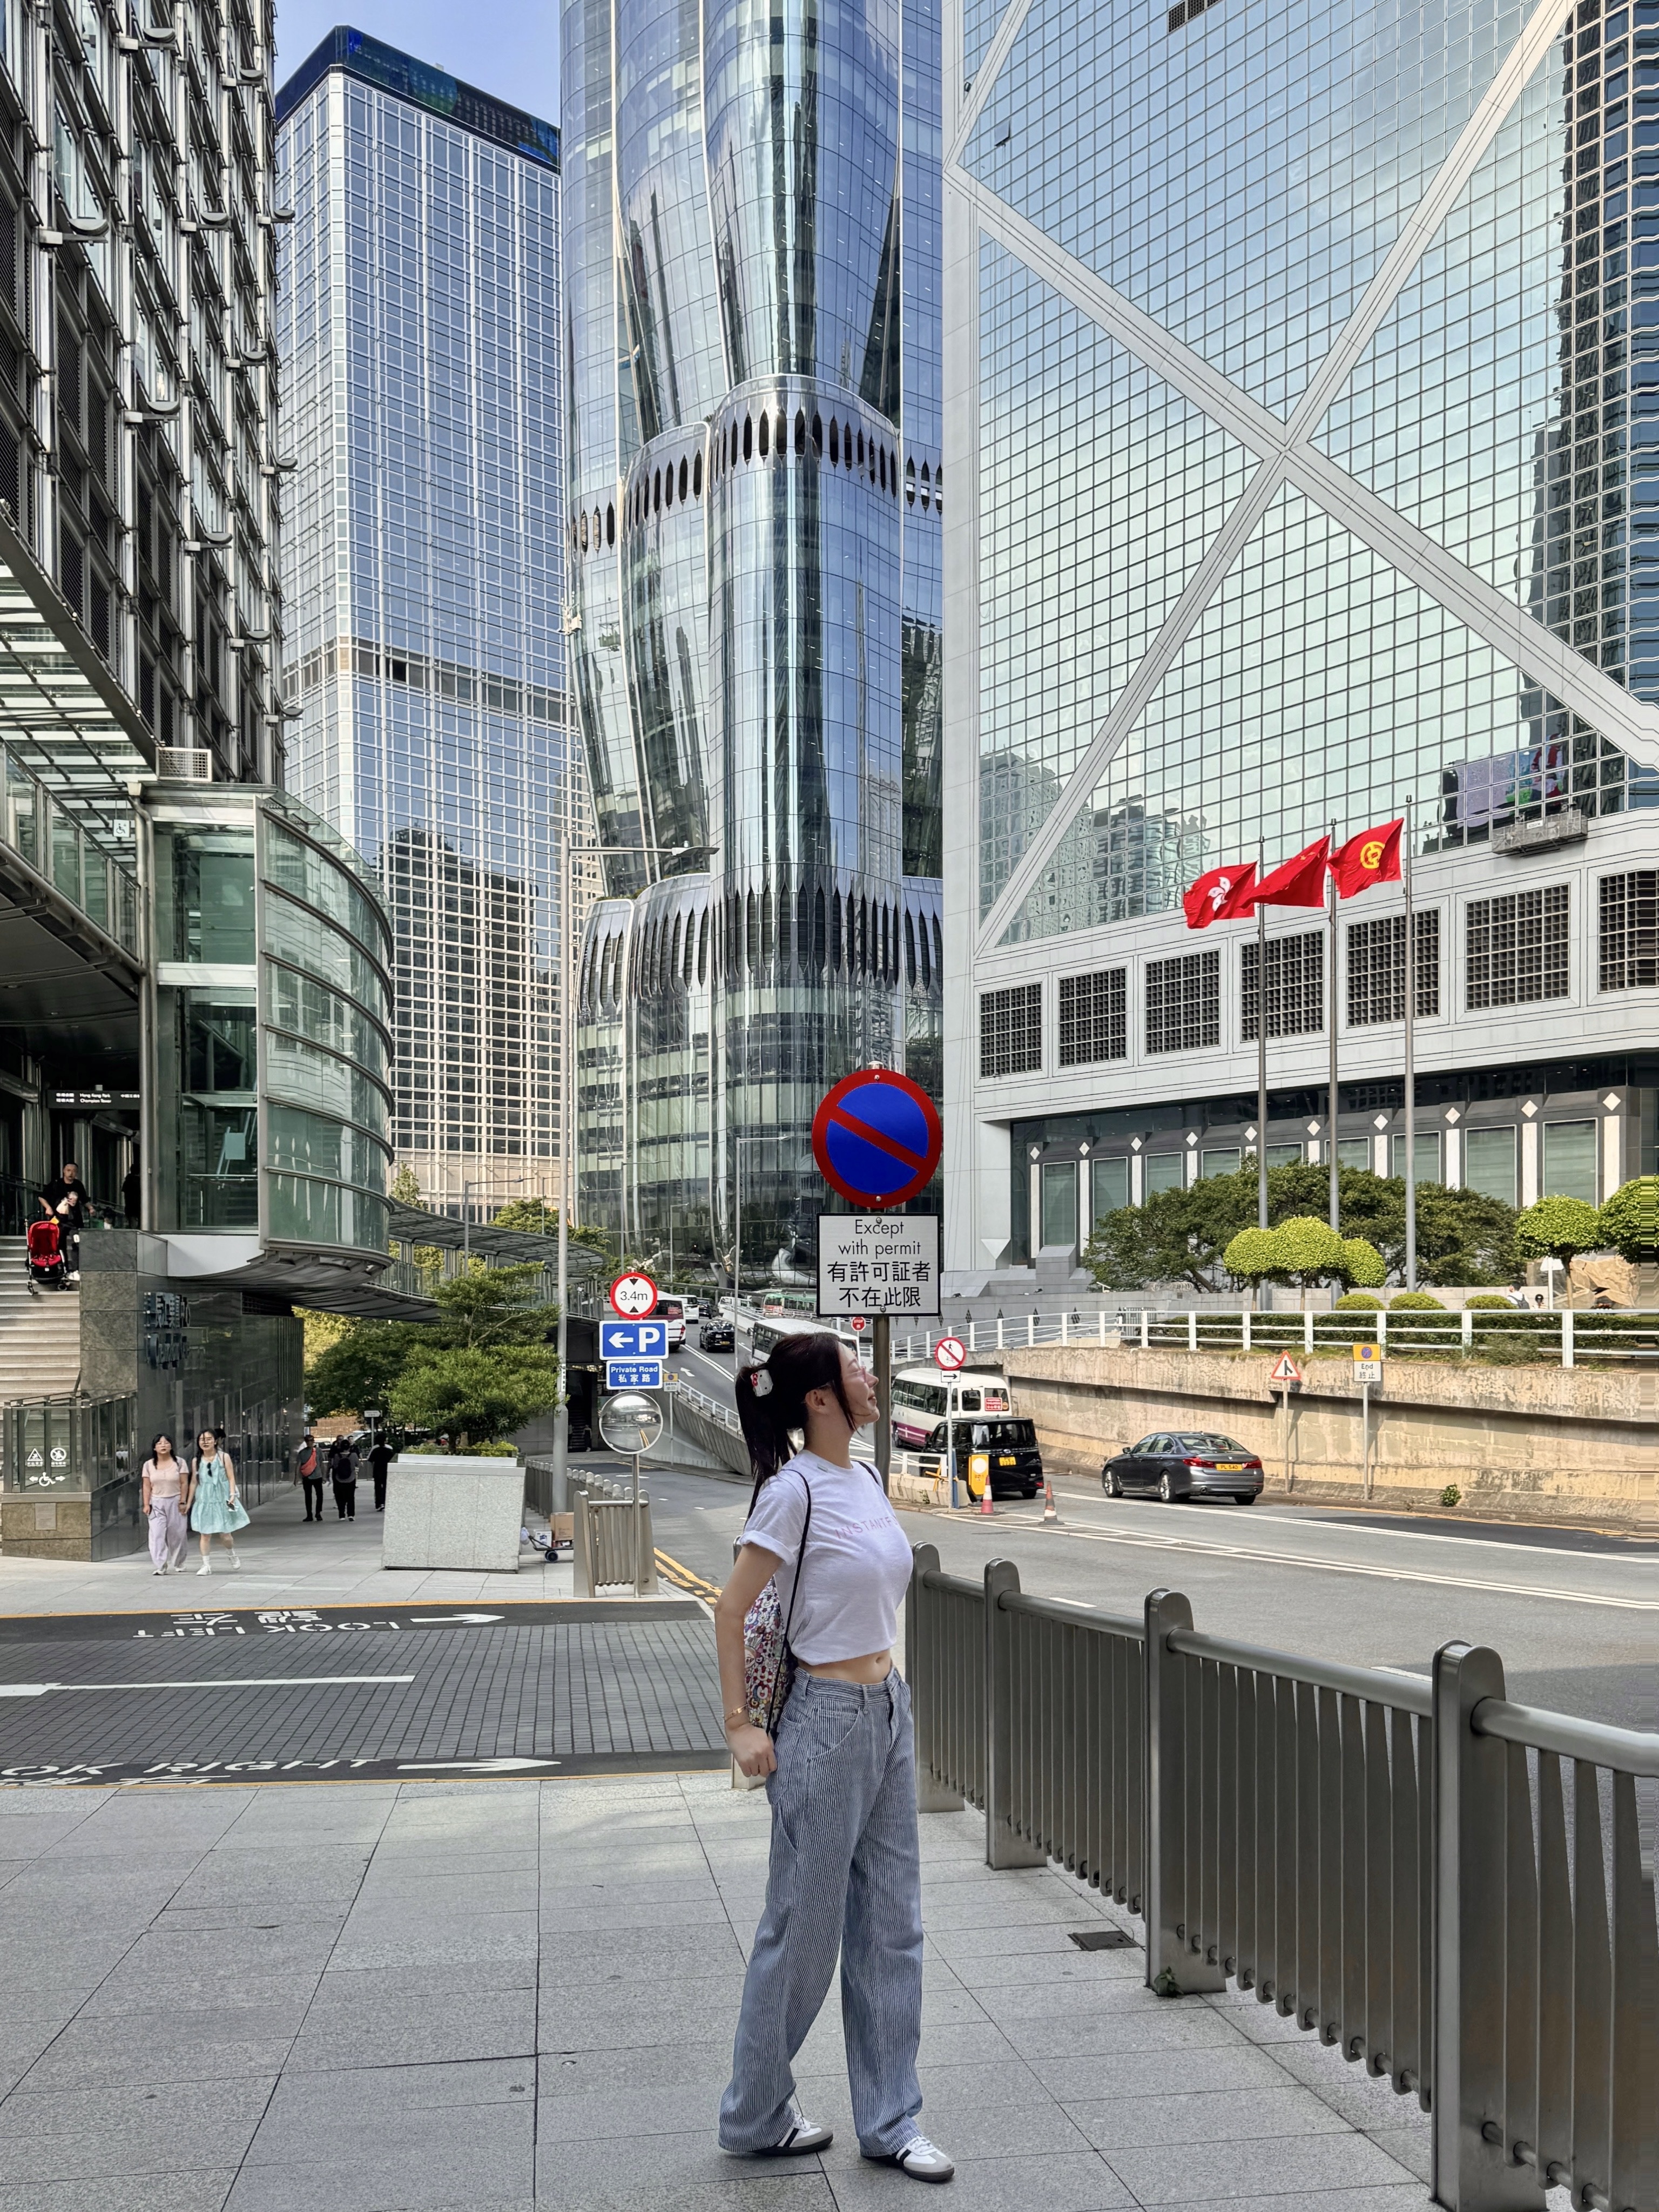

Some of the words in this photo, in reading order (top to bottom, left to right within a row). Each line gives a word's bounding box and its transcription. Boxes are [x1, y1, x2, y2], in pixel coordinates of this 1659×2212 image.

[855, 1219, 904, 1239] Except
[838, 1238, 868, 1255] with
[875, 1240, 921, 1259] permit
[827, 1260, 931, 1282] 有許可証者
[621, 1291, 648, 1300] 3.4m
[839, 1286, 921, 1308] 不在此限
[639, 1327, 660, 1352] P
[618, 1374, 650, 1382] 私家路
[133, 1626, 246, 1637] LEFT
[263, 1621, 400, 1633] LOOK
[143, 1759, 380, 1772] RIGHT
